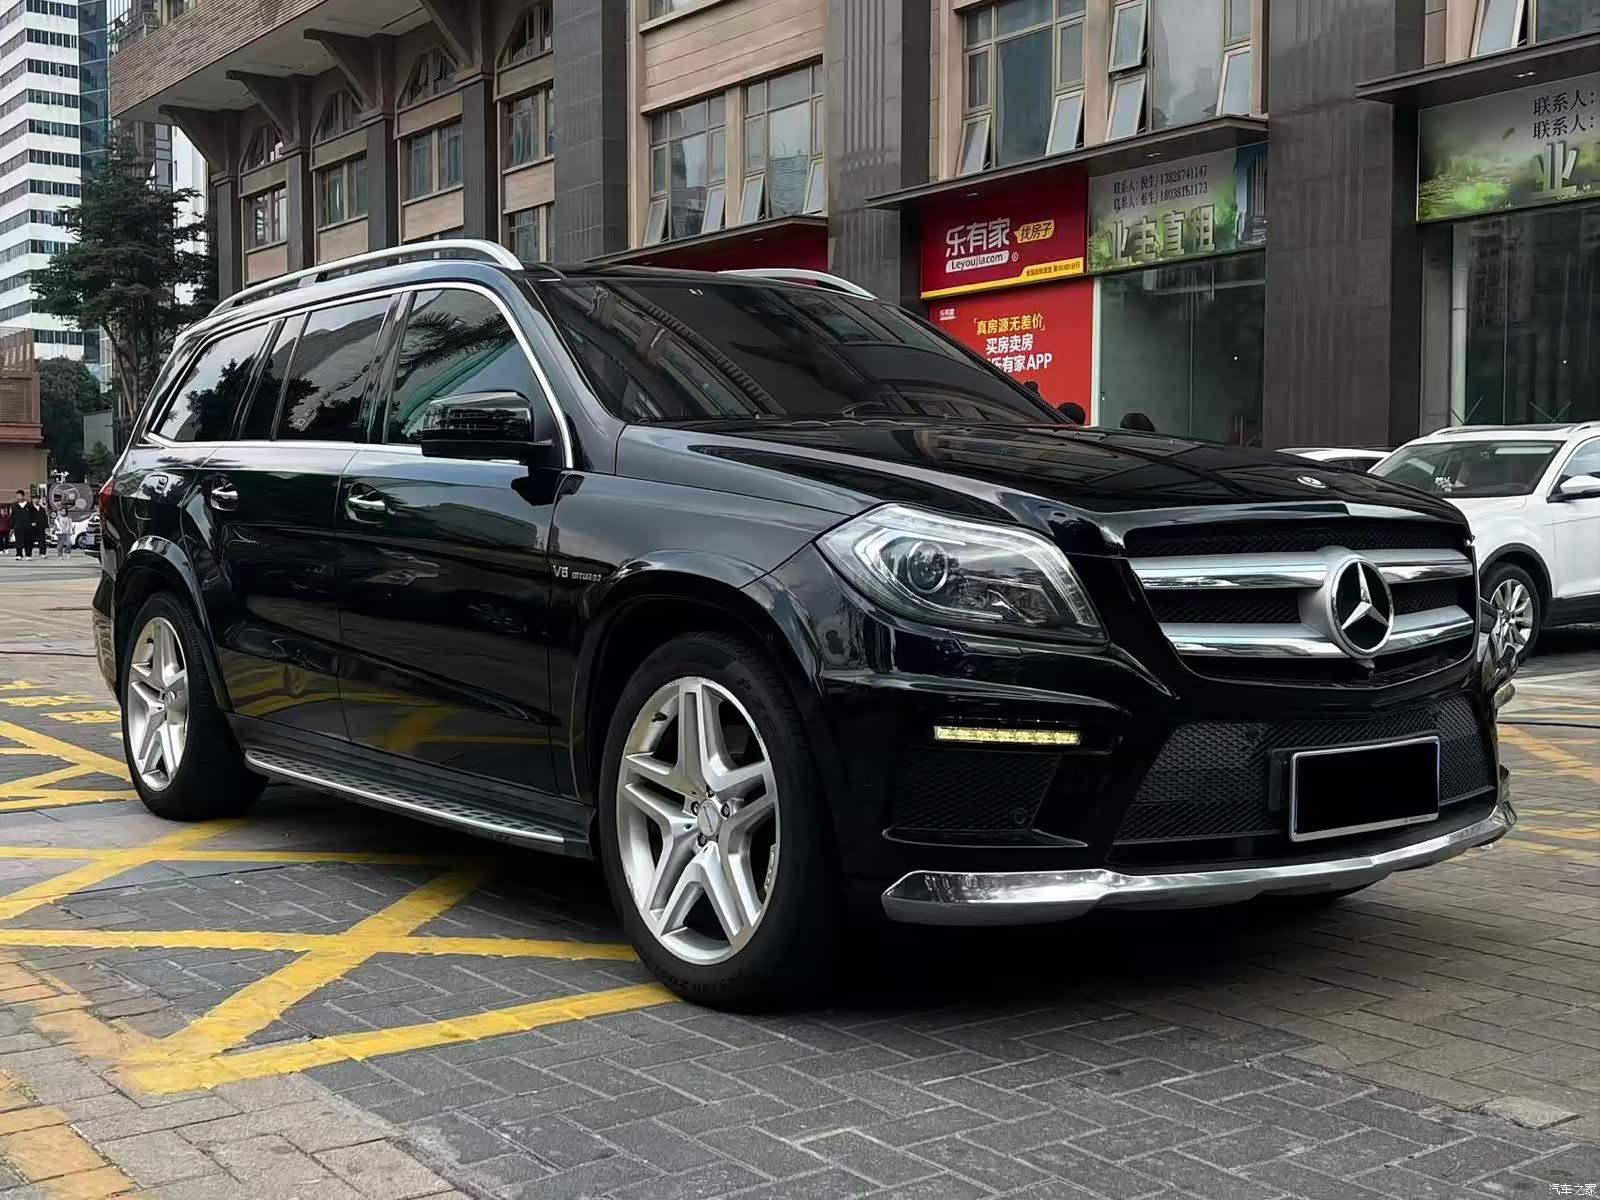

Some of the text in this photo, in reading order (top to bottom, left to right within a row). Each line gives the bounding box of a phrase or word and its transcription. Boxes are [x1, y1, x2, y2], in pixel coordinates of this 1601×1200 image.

[945, 217, 1010, 258] 乐有家
[1020, 221, 1053, 242] 找房子
[1109, 204, 1215, 262] 业主直租
[986, 333, 1034, 355] 买房卖房
[987, 352, 1053, 374] 乐有家APP
[552, 565, 569, 578] V8
